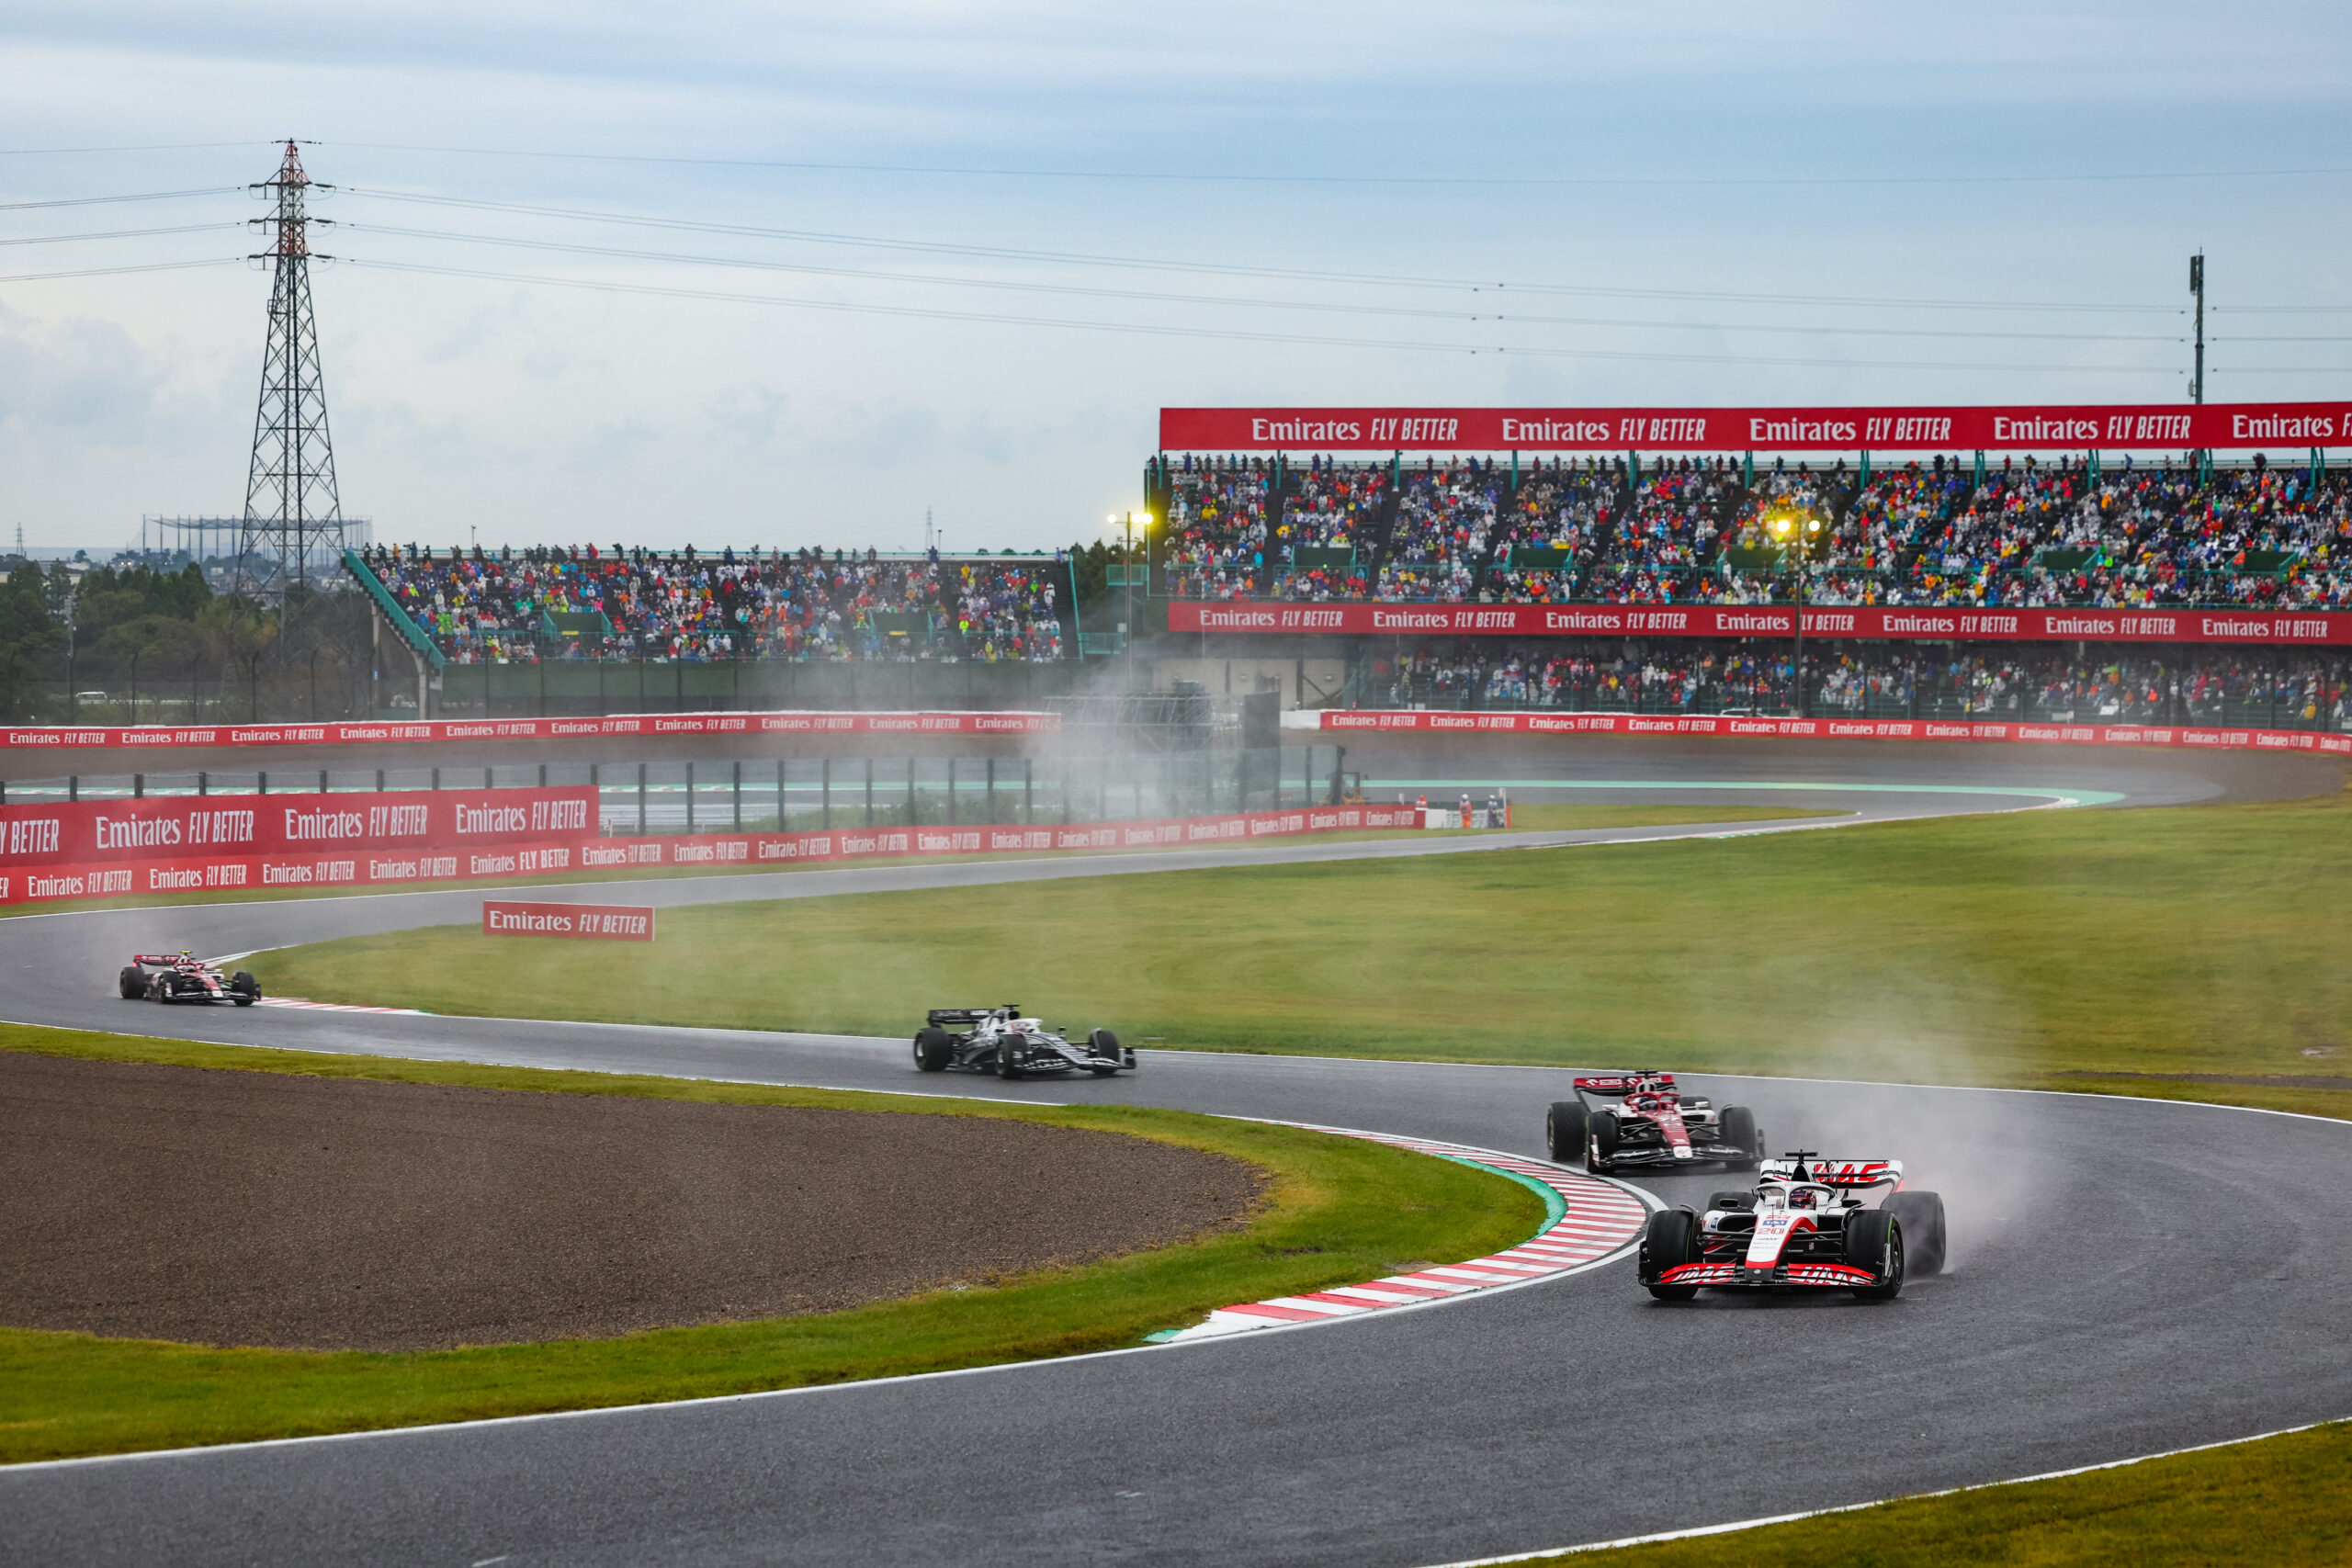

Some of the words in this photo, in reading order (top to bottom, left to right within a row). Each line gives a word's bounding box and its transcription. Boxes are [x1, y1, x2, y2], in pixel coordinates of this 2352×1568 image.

[1252, 418, 1360, 440] Emirates
[1371, 419, 1397, 440] FLY
[1400, 419, 1458, 440] BETTER
[1503, 418, 1610, 441] Emirates
[1620, 419, 1646, 440] FLY
[1649, 419, 1705, 441] BETTER
[1750, 418, 1857, 441] Emirates
[1866, 418, 1893, 440] FLY
[1894, 418, 1951, 440] BETTER
[1995, 416, 2098, 439] Emirates
[2107, 416, 2132, 439] FLY
[2135, 416, 2190, 439] BETTER
[2233, 413, 2333, 438] Emirates
[1200, 610, 1275, 626] Emirates
[1282, 611, 1301, 626] FLY
[1302, 611, 1342, 626] BETTER
[1374, 612, 1448, 626] Emirates
[1455, 612, 1474, 627] FLY
[1476, 612, 1515, 627] BETTER
[1546, 613, 1620, 628] Emirates
[1627, 614, 1645, 628] FLY
[1647, 614, 1687, 628] BETTER
[1716, 614, 1789, 629] Emirates
[1801, 615, 1814, 630] LY
[1815, 615, 1854, 630] BETTER
[1883, 615, 1954, 632] Emirates
[1961, 616, 1978, 632] FLY
[1980, 616, 2017, 632] BETTER
[2046, 617, 2114, 634] Emirates
[2121, 618, 2138, 634] FLY
[2140, 618, 2175, 634] BETTER
[2202, 619, 2268, 636] Emirates
[2275, 620, 2291, 637] FLY
[2292, 621, 2327, 637] BETTER
[551, 723, 598, 733] Emirates
[602, 722, 614, 731] FLY
[615, 721, 640, 731] BETTER
[655, 720, 703, 730] Emirates
[707, 720, 718, 729] FLY
[719, 719, 746, 729] BETTER
[762, 718, 809, 728] Emirates
[814, 718, 826, 728] FLY
[827, 718, 853, 728] BETTER
[870, 718, 918, 728] Emirates
[1332, 716, 1376, 726] Emirates
[1380, 716, 1391, 726] FLY
[1392, 716, 1416, 726] BETTER
[1430, 716, 1475, 727] Emirates
[1478, 717, 1490, 728] FLY
[1490, 717, 1515, 728] BETTER
[1529, 717, 1575, 728] Emirates
[1577, 718, 1589, 728] FLY
[1589, 718, 1615, 728] BETTER
[1629, 719, 1674, 730] Emirates
[1678, 720, 1690, 730] FLY
[1690, 720, 1716, 731] BETTER
[1730, 721, 1776, 732] Emirates
[1780, 722, 1791, 733] FLY
[1792, 723, 1815, 733] BETTER
[1829, 723, 1873, 734] Emirates
[1877, 724, 1888, 735] FLY
[1889, 724, 1913, 735] BETTER
[10, 733, 60, 743] Emirates
[64, 733, 77, 743] FLY
[78, 733, 106, 743] BETTER
[122, 733, 172, 743] Emirates
[175, 732, 188, 742] FLY
[188, 731, 215, 742] BETTER
[232, 730, 281, 741] Emirates
[284, 729, 297, 739] FLY
[298, 729, 324, 739] BETTER
[340, 728, 388, 739] Emirates
[390, 728, 403, 737] FLY
[404, 727, 431, 737] BETTER
[447, 726, 493, 736] Emirates
[497, 725, 509, 735] FLY
[510, 724, 536, 734] BETTER
[1927, 725, 1970, 736] Emirates
[1973, 726, 1984, 736] FLY
[1984, 727, 2007, 737] BETTER
[285, 807, 363, 839] Emirates
[369, 807, 388, 836] FLY
[389, 806, 427, 835] BETTER
[456, 803, 526, 833] Emirates
[532, 802, 548, 830] FLY
[550, 800, 586, 829] BETTER
[10, 819, 59, 853] BETTER
[96, 814, 181, 848] Emirates
[188, 812, 209, 843] FLY
[210, 810, 254, 842] BETTER
[582, 846, 627, 864] Emirates
[628, 845, 639, 863] FLY
[639, 844, 662, 862] BETTER
[673, 843, 714, 861] Emirates
[717, 842, 727, 860] FLY
[727, 842, 748, 860] BETTER
[369, 859, 416, 878] Emirates
[420, 858, 432, 876] FLY
[432, 857, 458, 876] BETTER
[471, 854, 515, 874] Emirates
[519, 851, 537, 870] FLY
[540, 849, 570, 868] BETTER
[150, 867, 202, 888] Emirates
[207, 866, 220, 886] FLY
[220, 864, 247, 885] BETTER
[263, 863, 312, 883] Emirates
[315, 862, 328, 881] FLY
[329, 861, 356, 880] BETTER
[28, 874, 84, 897] Emirates
[87, 873, 102, 893] FLY
[103, 870, 132, 892] BETTER
[490, 911, 571, 931] Emirates
[580, 914, 601, 931] FLY
[603, 915, 647, 933] BETTER
[1757, 1227, 1785, 1235] 20
